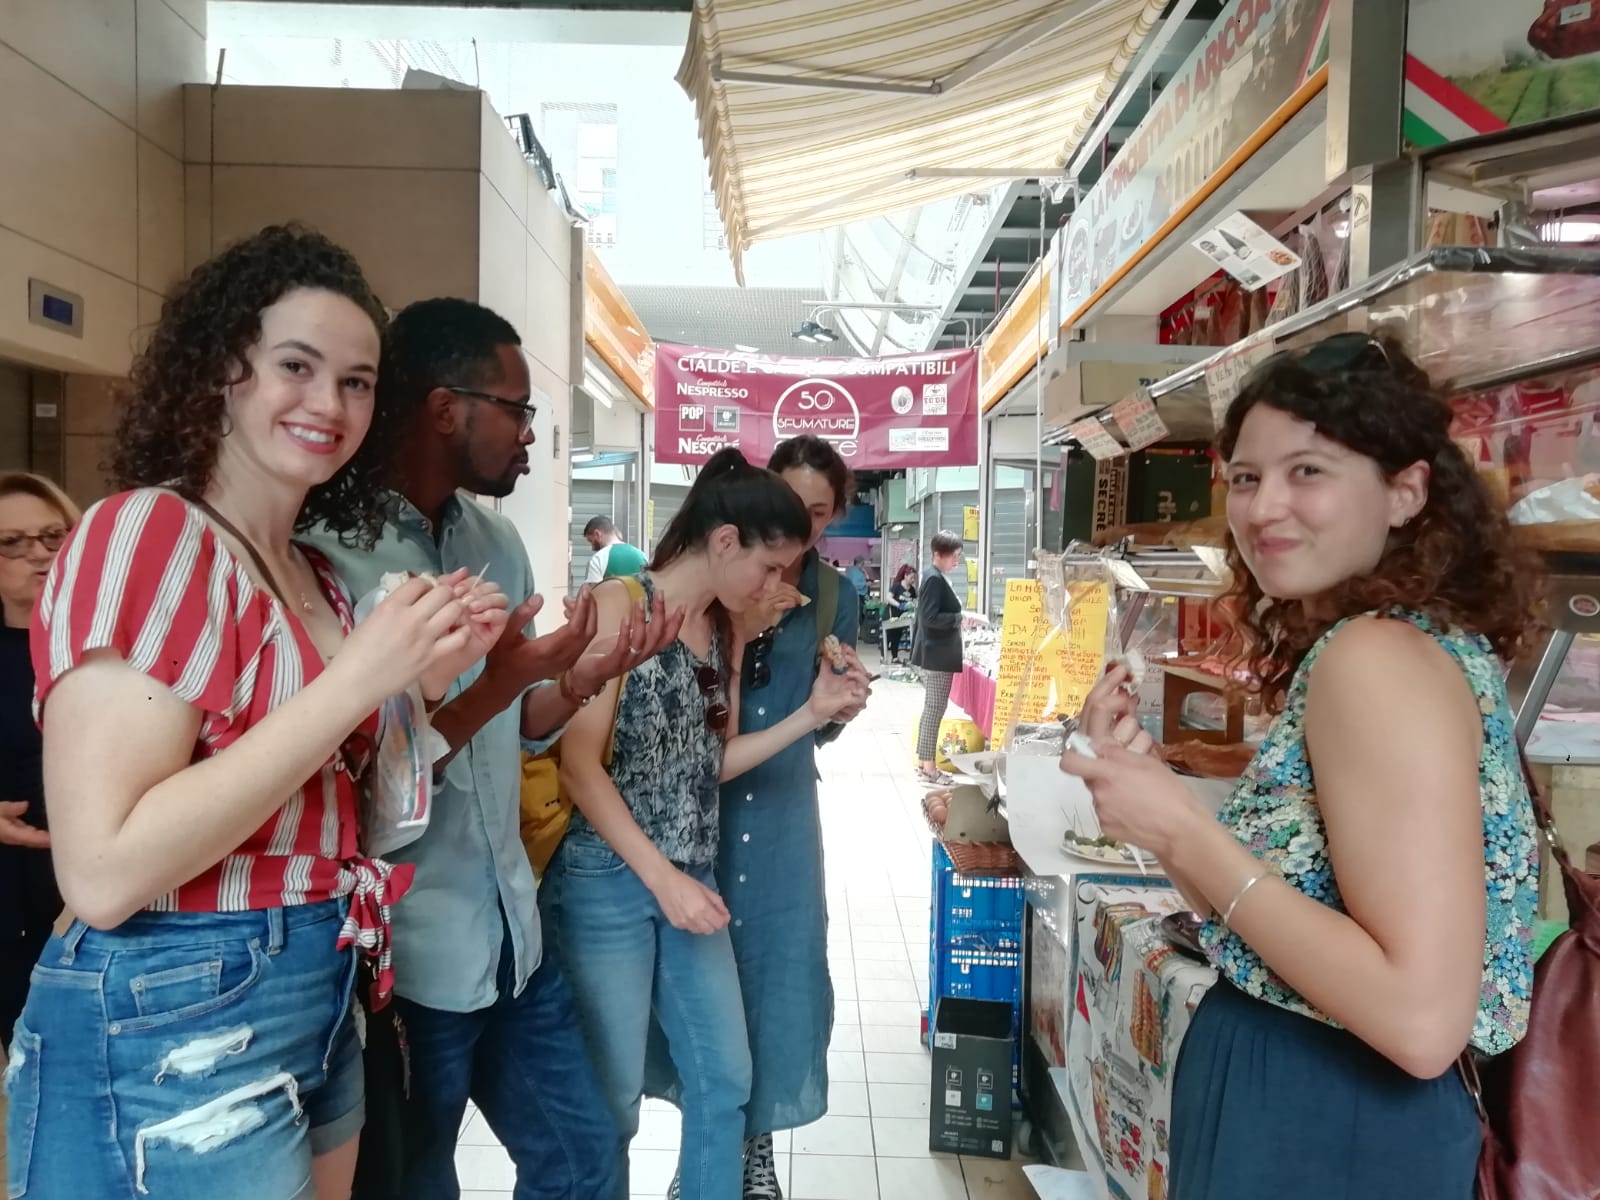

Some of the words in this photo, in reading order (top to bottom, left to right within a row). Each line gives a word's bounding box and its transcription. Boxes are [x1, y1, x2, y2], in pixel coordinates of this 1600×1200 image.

[677, 357, 741, 373] CIALDE
[676, 381, 749, 399] NESPRESSO
[798, 390, 834, 411] 50
[681, 406, 704, 420] POP
[777, 417, 855, 430] SFUMATURE
